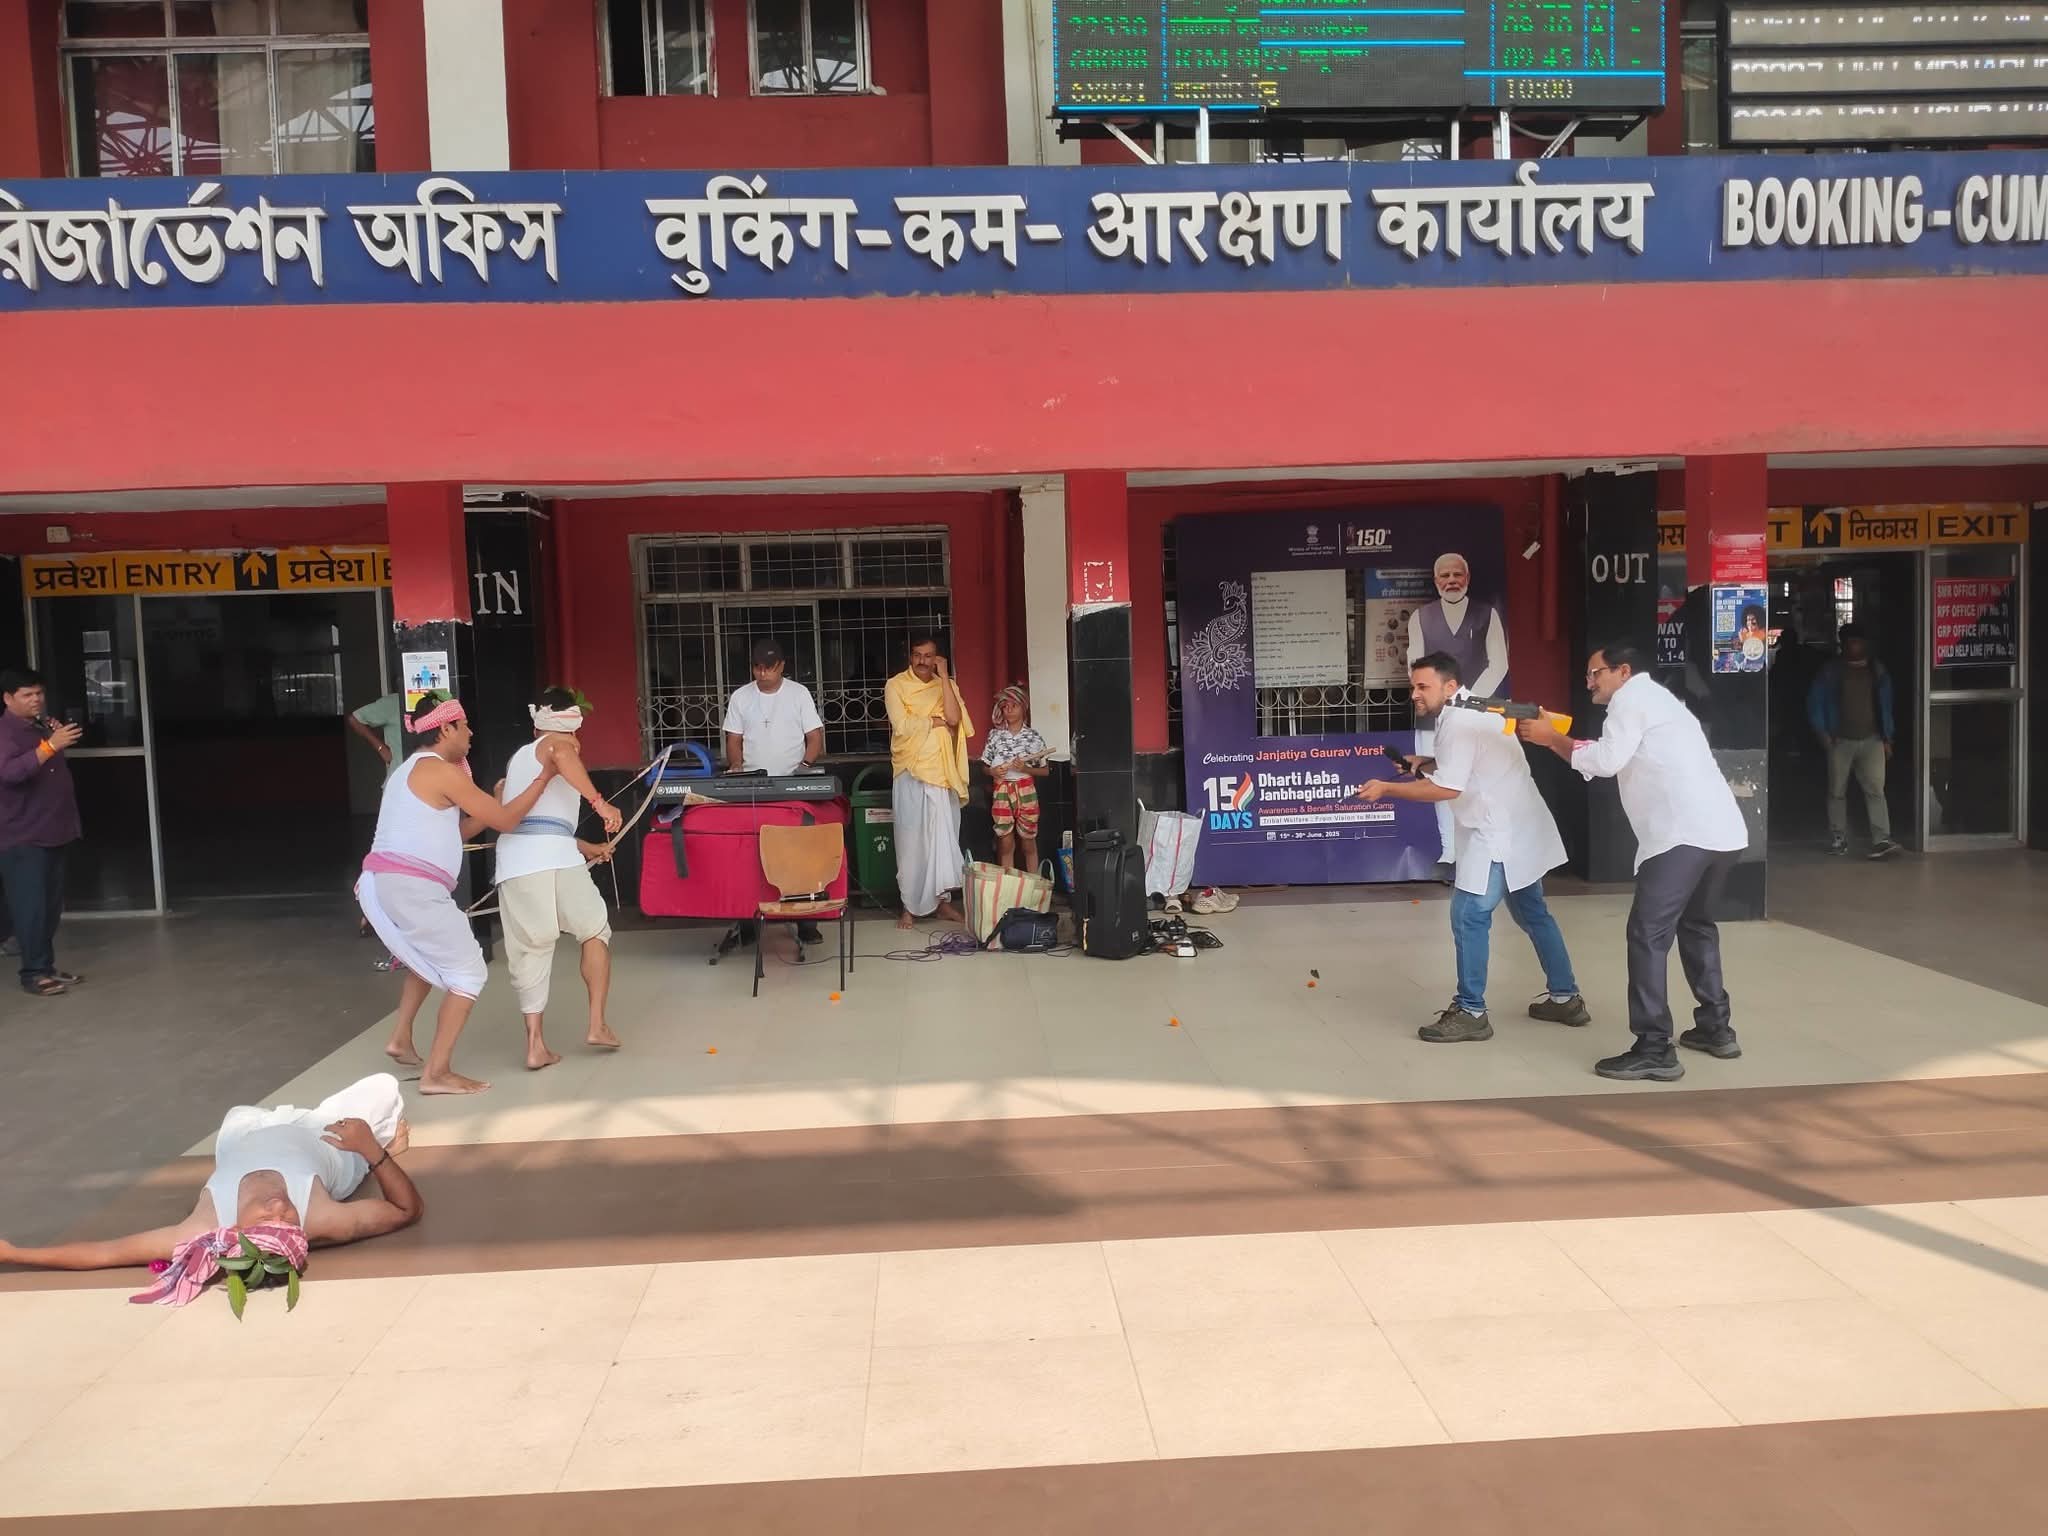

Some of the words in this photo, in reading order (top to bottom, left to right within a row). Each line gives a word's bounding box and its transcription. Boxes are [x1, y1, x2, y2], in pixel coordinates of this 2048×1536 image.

[1087, 190, 1352, 268] आरक्षण
[1372, 161, 1655, 258] कार्यालय
[347, 178, 562, 285] অফিস
[1849, 510, 1919, 541] निकास
[1937, 514, 2017, 538] EXIT
[33, 560, 108, 591] प्रवेश
[126, 562, 221, 587] ENTRY
[288, 549, 366, 584] प्रवेश
[1592, 553, 1649, 584] OUT
[473, 570, 522, 615] IN
[1953, 583, 1977, 597] OFFICE
[1951, 603, 1976, 617] OFFICE
[1952, 623, 1977, 637] OFFICE
[1664, 637, 1677, 649] TO
[1203, 752, 1254, 764] Celebrating
[1256, 748, 1307, 762] Janjatiya
[1310, 748, 1351, 758] Gaurav
[1258, 771, 1302, 788] Dharti
[1304, 770, 1340, 785] Aaba
[665, 786, 692, 794] YAMAHA
[1203, 776, 1239, 811] 15
[1259, 785, 1341, 803] Janbhagidari
[1258, 807, 1298, 815] Awareness
[1373, 801, 1395, 810] Camp
[1210, 811, 1254, 831] DAYS
